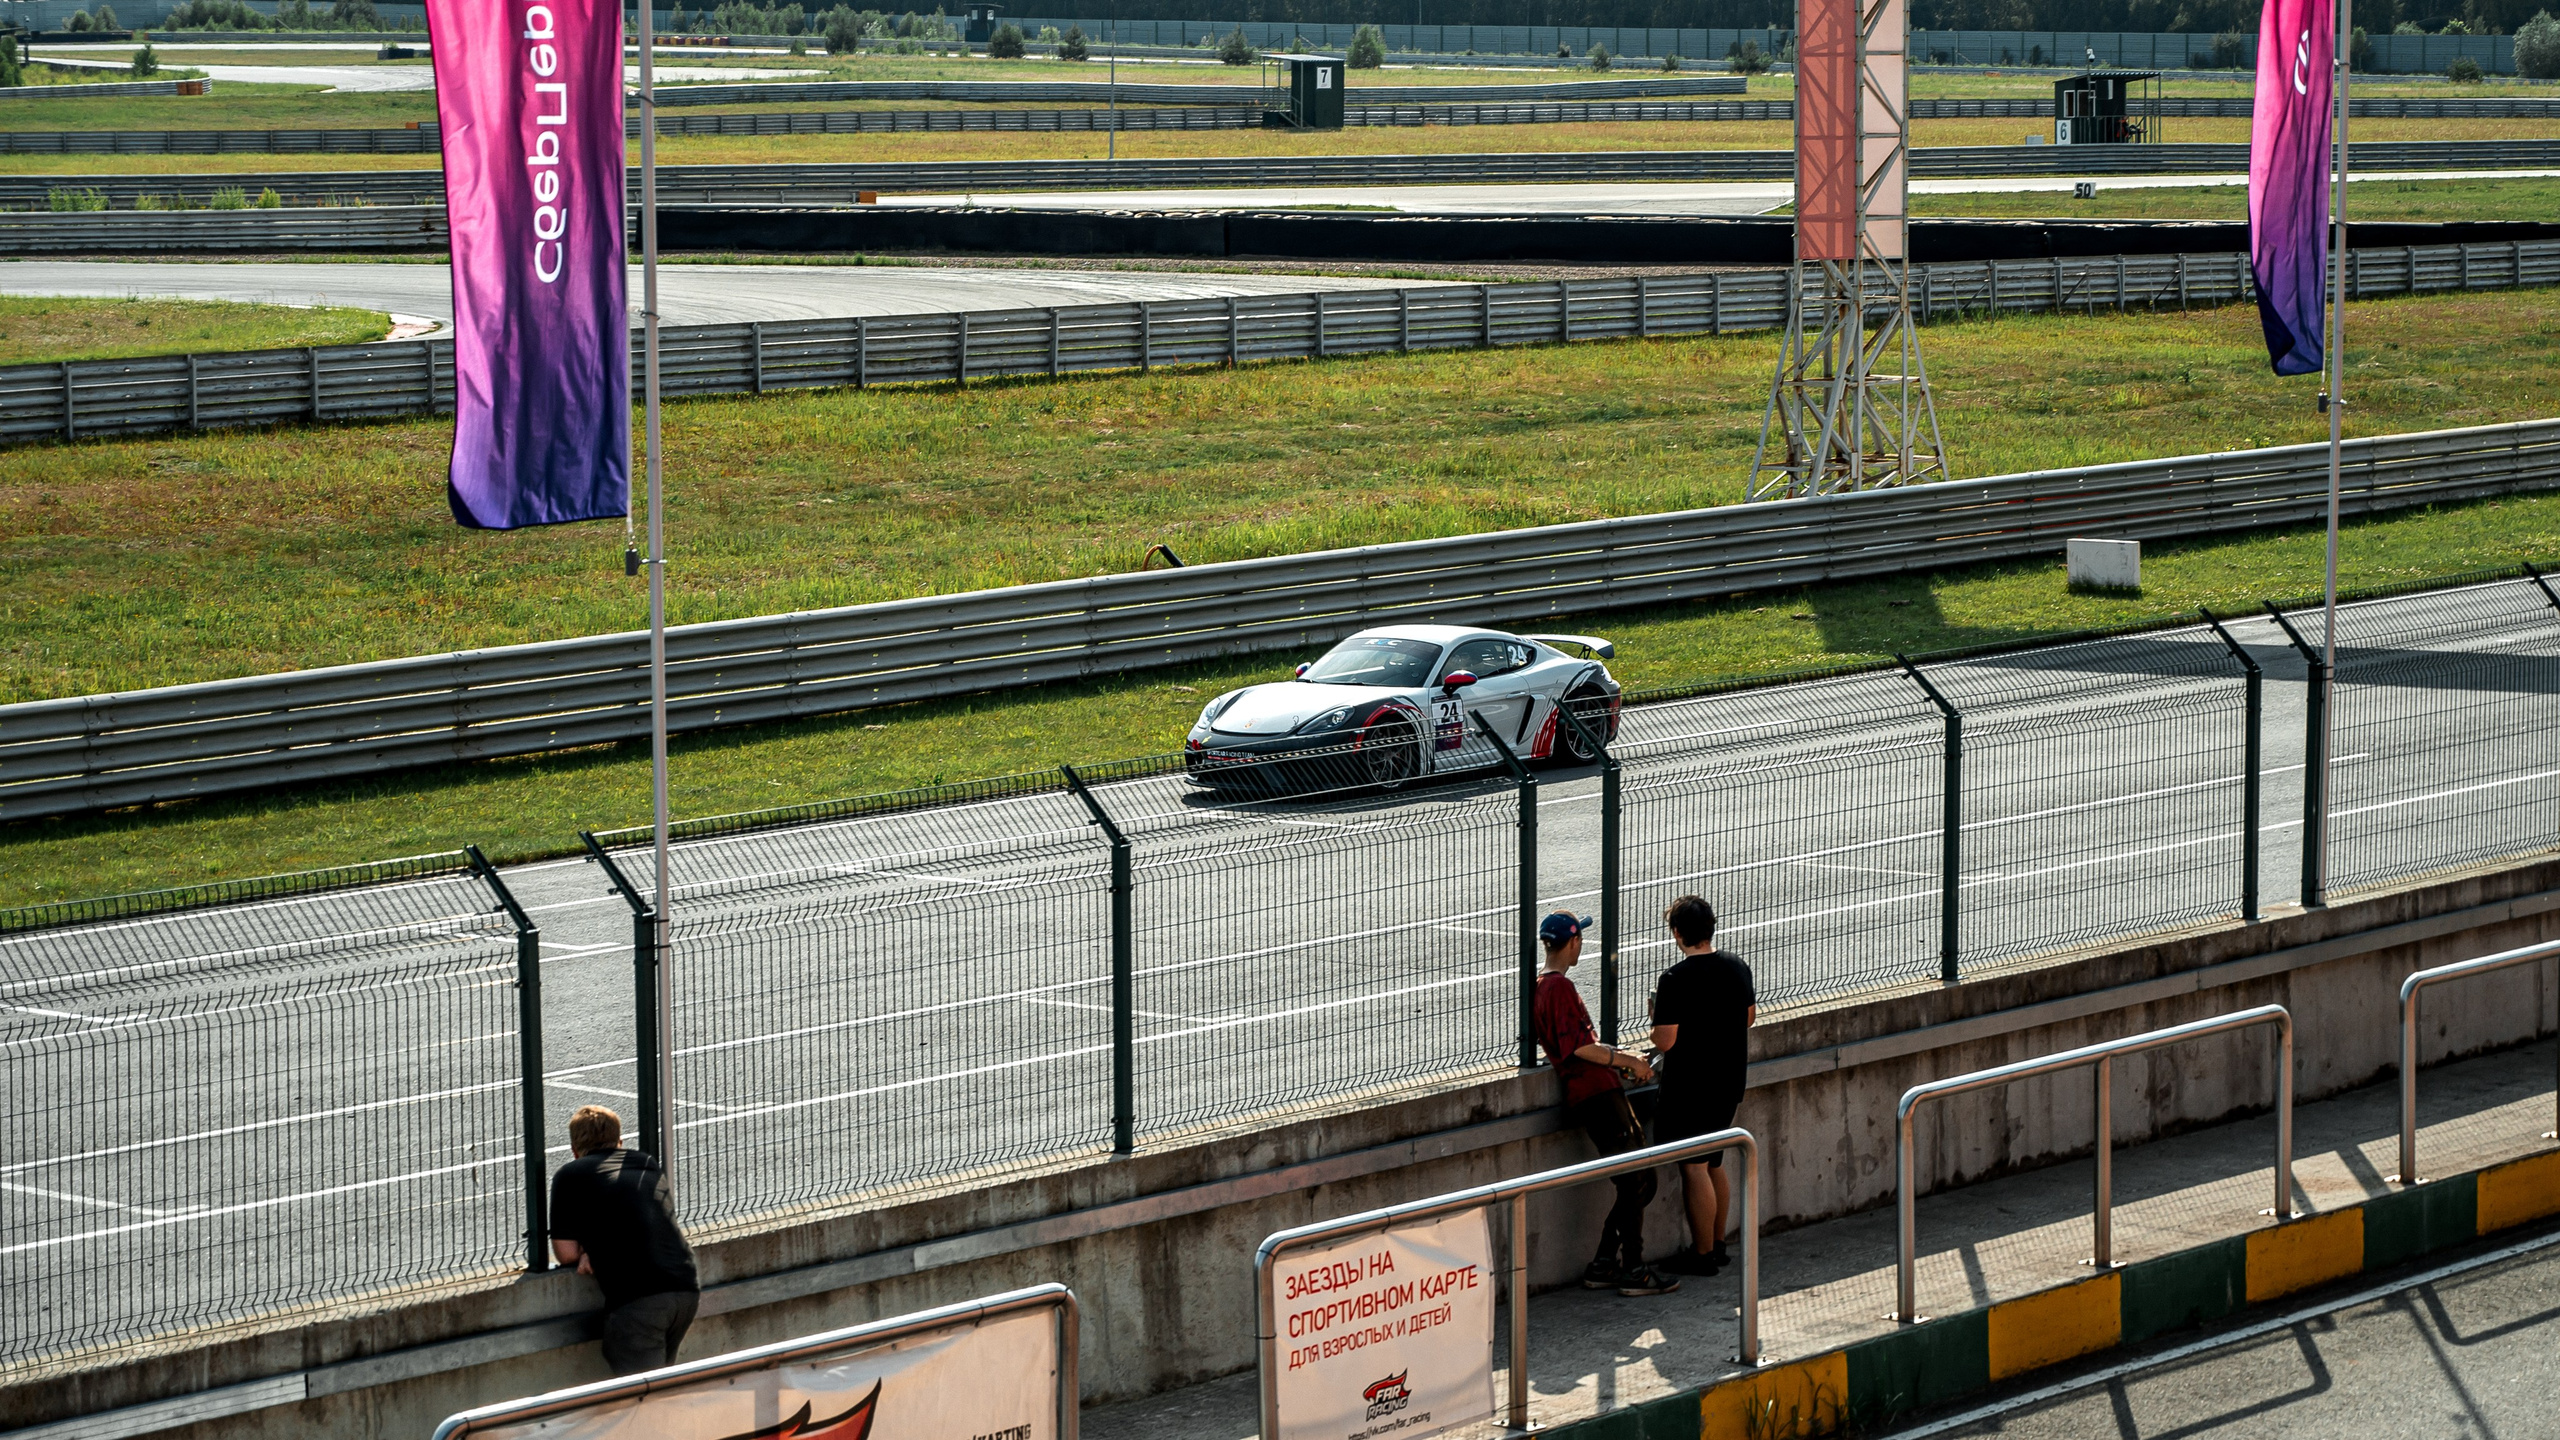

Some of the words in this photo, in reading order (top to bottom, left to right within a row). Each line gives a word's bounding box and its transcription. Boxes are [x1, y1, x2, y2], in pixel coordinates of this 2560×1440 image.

[1321, 69, 1328, 83] 7
[2060, 122, 2067, 141] 6
[2074, 183, 2092, 198] 50
[1507, 645, 1528, 665] 24
[1440, 702, 1459, 723] 24
[1285, 1257, 1364, 1300] ЗАЕЗДЫ
[1369, 1250, 1395, 1278] НА
[1288, 1281, 1414, 1338] СПОРТИВНОМ
[1419, 1264, 1478, 1301] КАРТЕ
[1288, 1343, 1320, 1372] ДЛЯ
[1322, 1321, 1394, 1359] ВЗРОСЛЫХ
[1396, 1318, 1406, 1337] И
[1409, 1302, 1452, 1336] ДЕТЕЙ
[1375, 1384, 1402, 1403] FAR
[1366, 1396, 1408, 1421] RACING
